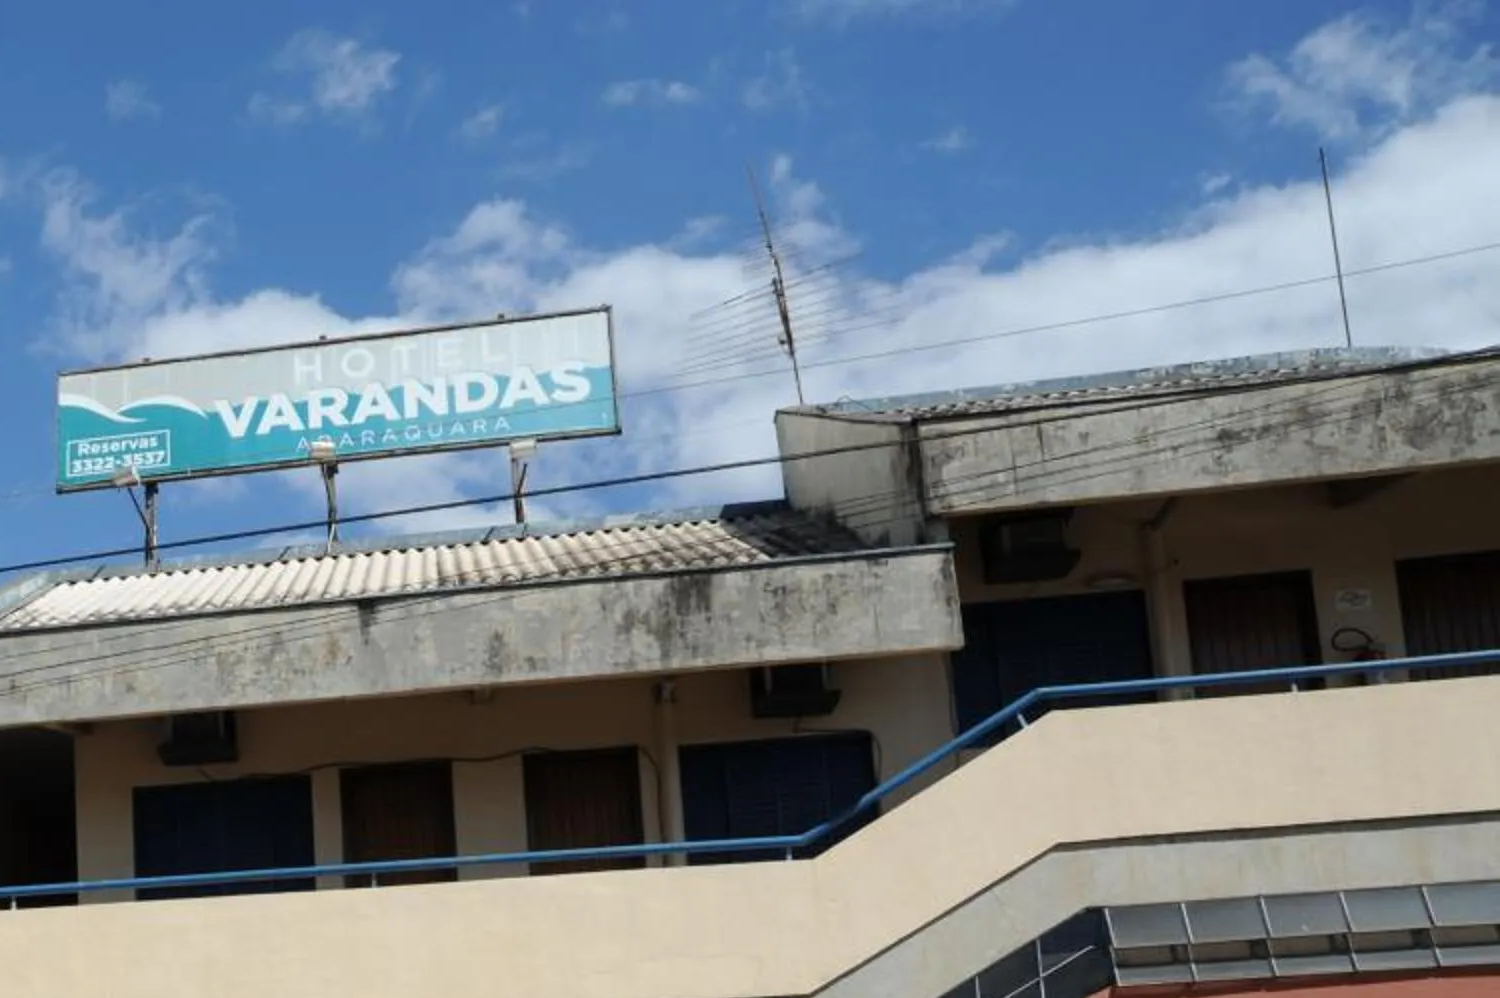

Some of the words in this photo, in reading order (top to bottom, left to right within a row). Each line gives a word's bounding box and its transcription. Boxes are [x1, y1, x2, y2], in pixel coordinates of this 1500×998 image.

[294, 335, 506, 383] HOTEL
[213, 360, 591, 438] VARANDAS
[77, 436, 159, 456] Reservas
